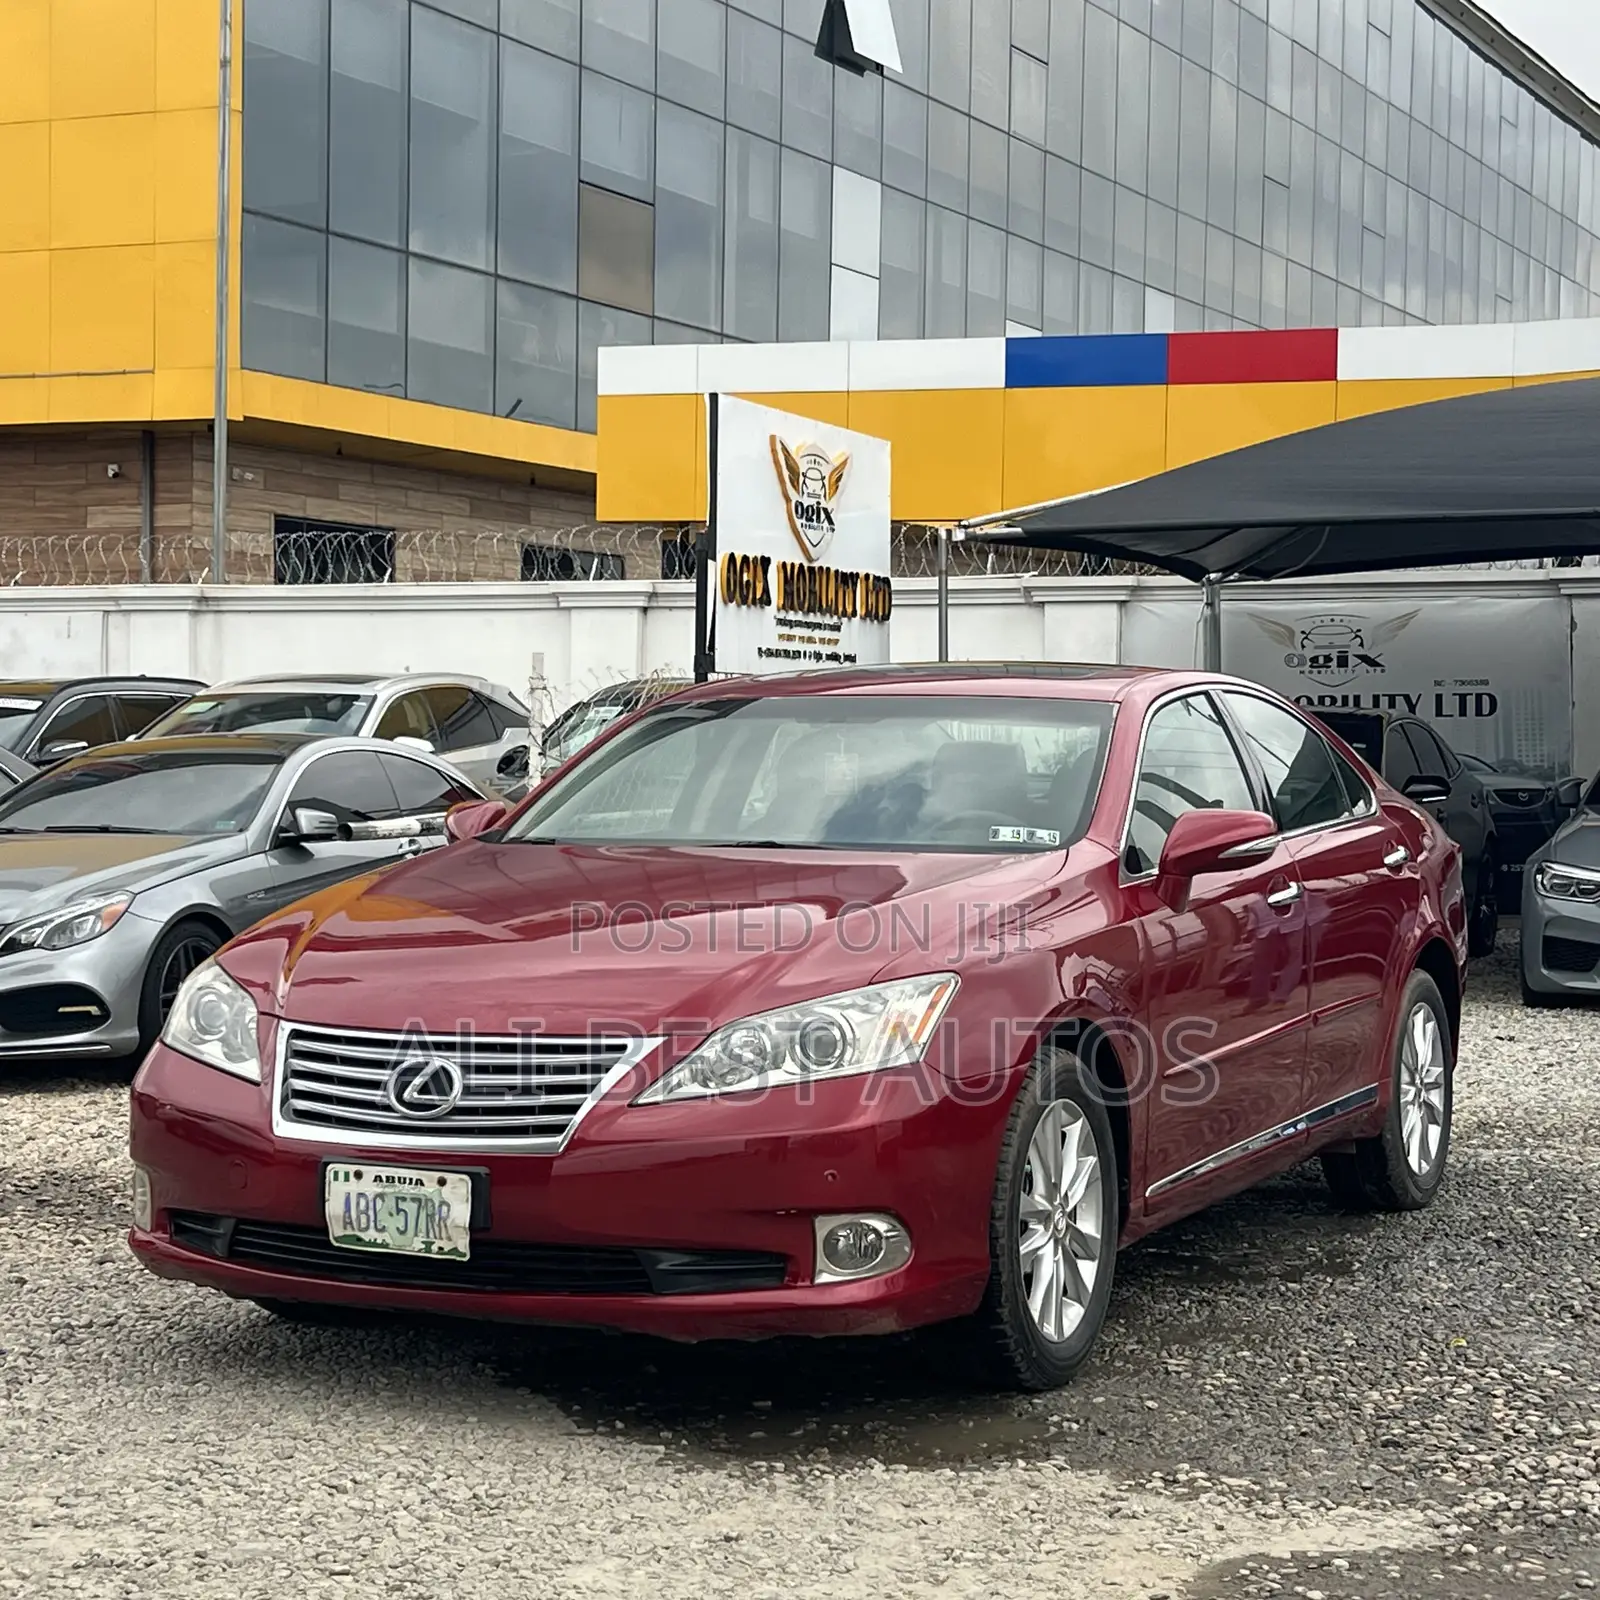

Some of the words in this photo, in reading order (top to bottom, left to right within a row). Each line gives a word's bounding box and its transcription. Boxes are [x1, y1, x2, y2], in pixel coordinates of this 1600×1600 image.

[720, 552, 772, 608] OGIX
[1435, 693, 1498, 718] LTD
[373, 1174, 425, 1187] ABUJA
